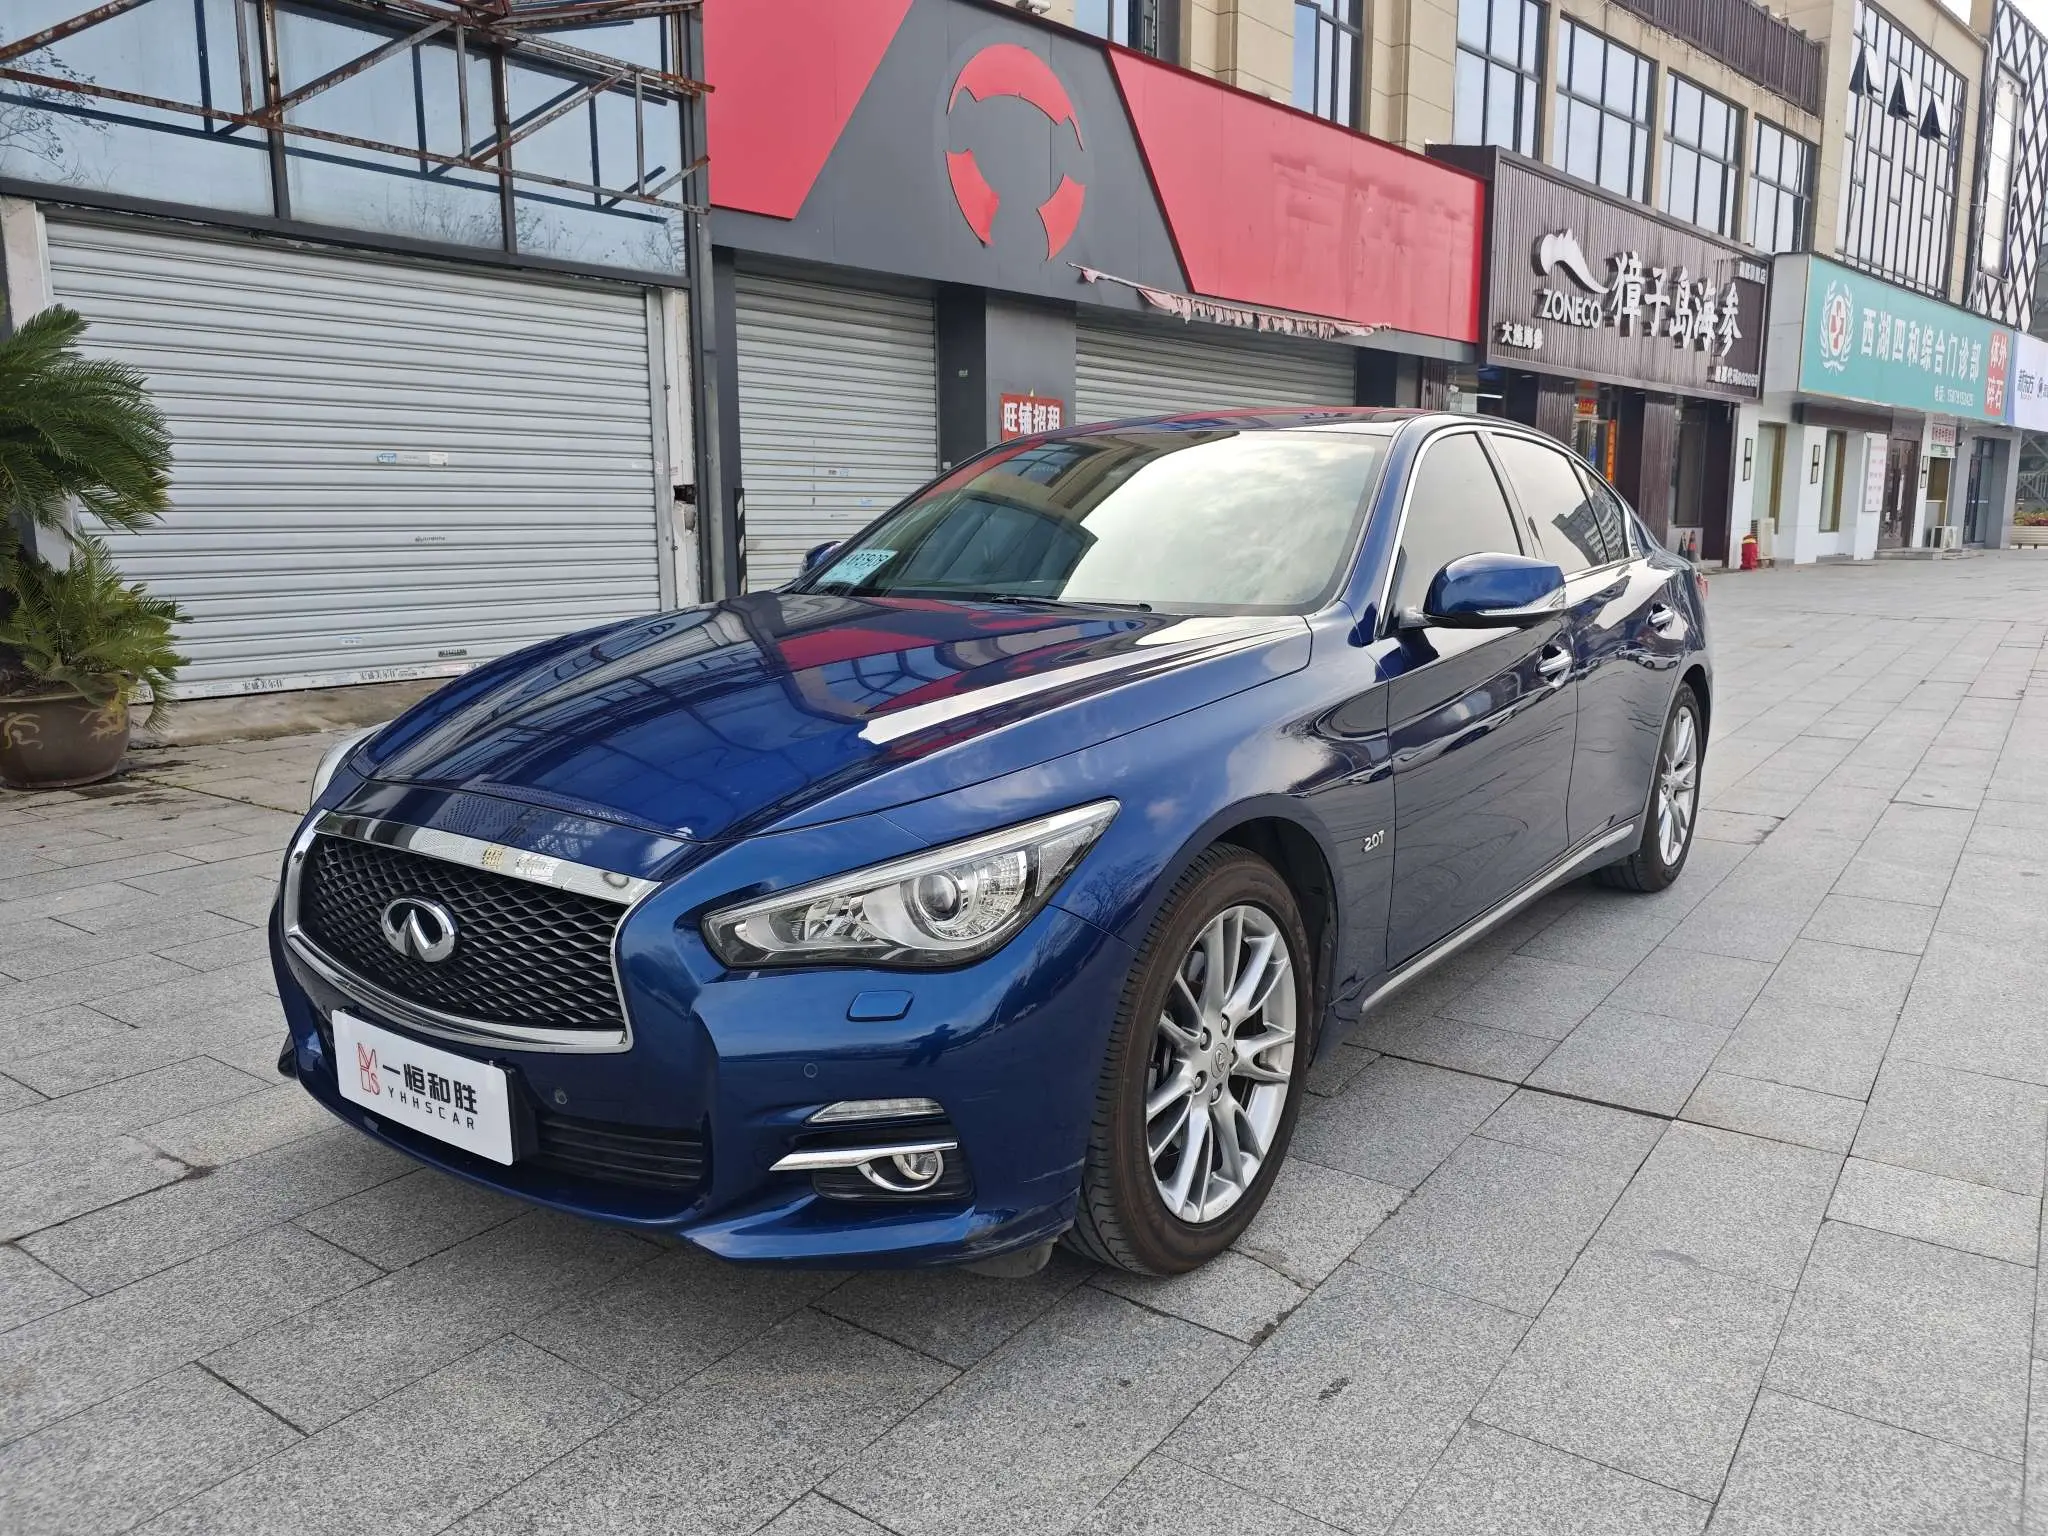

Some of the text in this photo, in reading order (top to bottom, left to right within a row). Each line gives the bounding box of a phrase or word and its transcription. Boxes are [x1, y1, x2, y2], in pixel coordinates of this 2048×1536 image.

[1542, 288, 1601, 329] ZONECO
[1611, 250, 1743, 358] 獐子岛海参
[1860, 307, 1982, 384] 西湖四和综合门诊部
[1003, 401, 1060, 434] 旺铺招租
[382, 1063, 479, 1115] 一恒和胜
